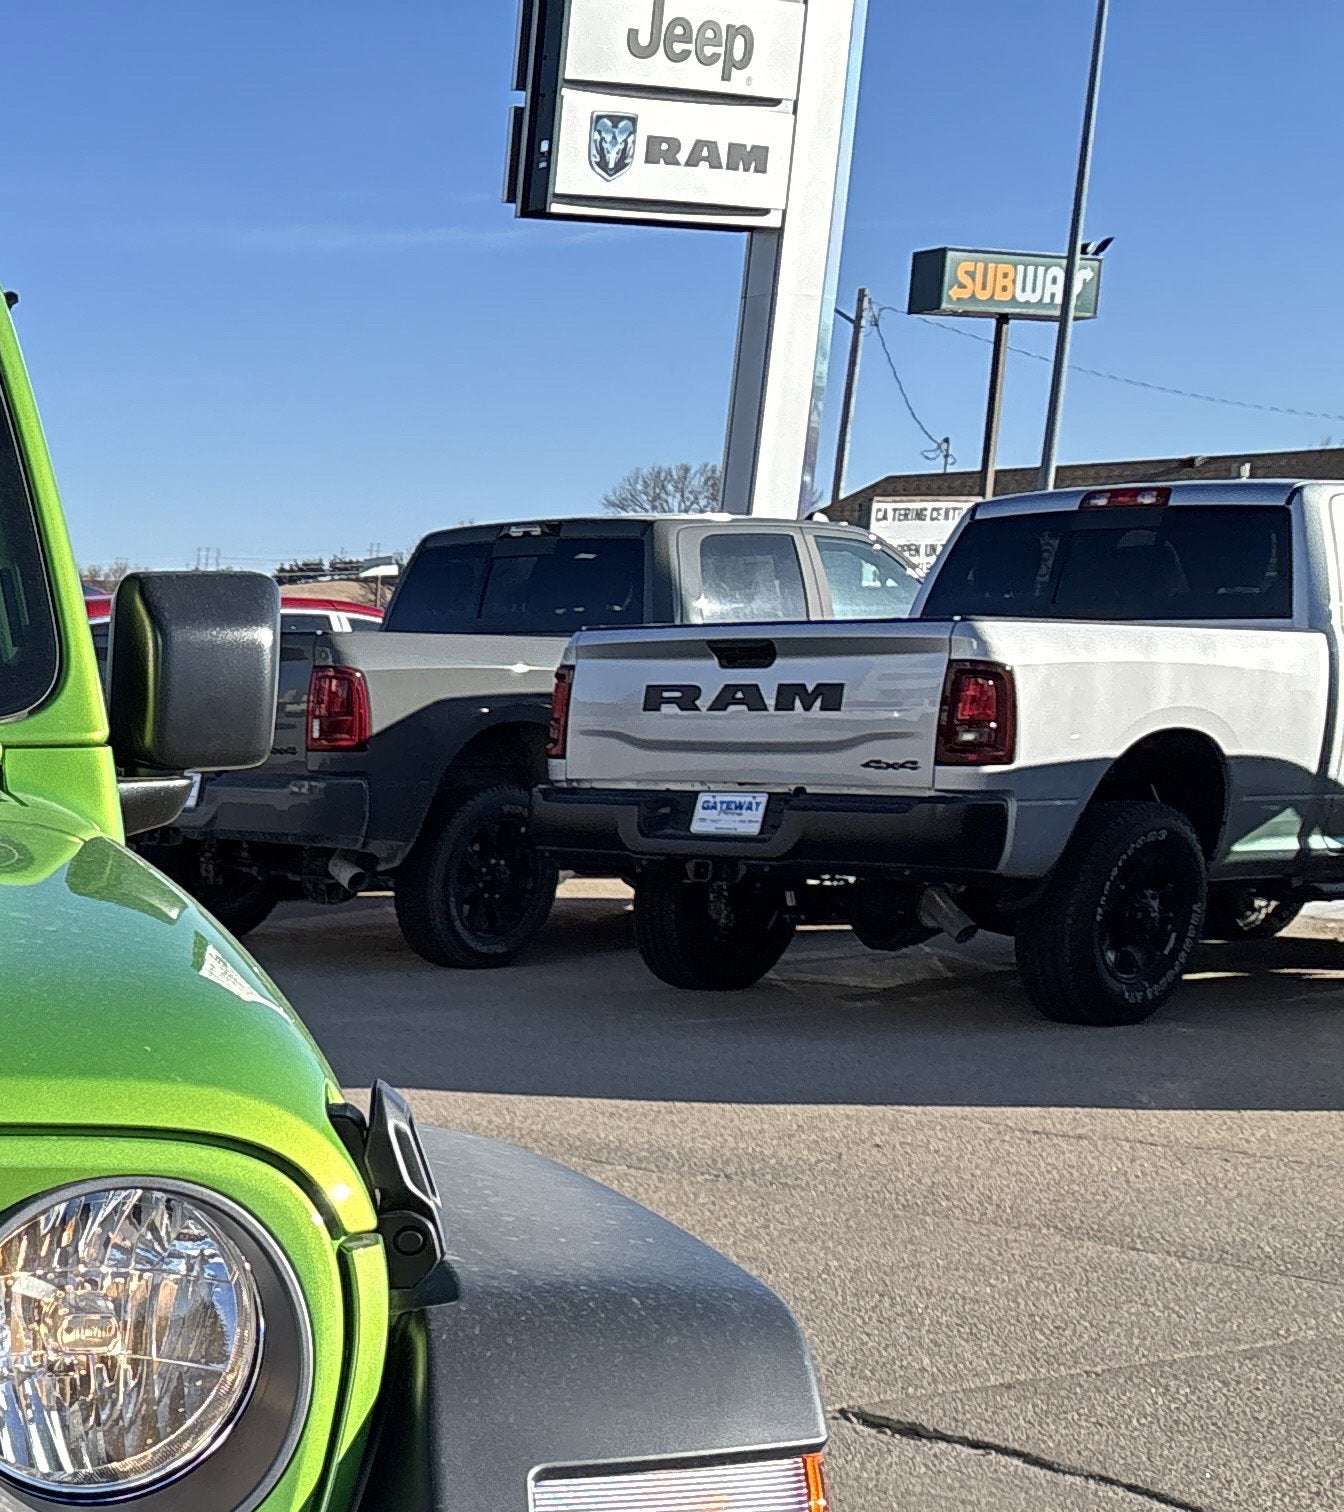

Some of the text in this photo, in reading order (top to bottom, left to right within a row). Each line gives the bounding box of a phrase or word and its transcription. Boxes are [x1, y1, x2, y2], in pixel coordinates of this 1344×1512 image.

[627, 0, 754, 82] Jeep
[644, 134, 770, 174] RAM
[642, 682, 846, 712] RAM
[701, 799, 763, 813] GATEWAY
